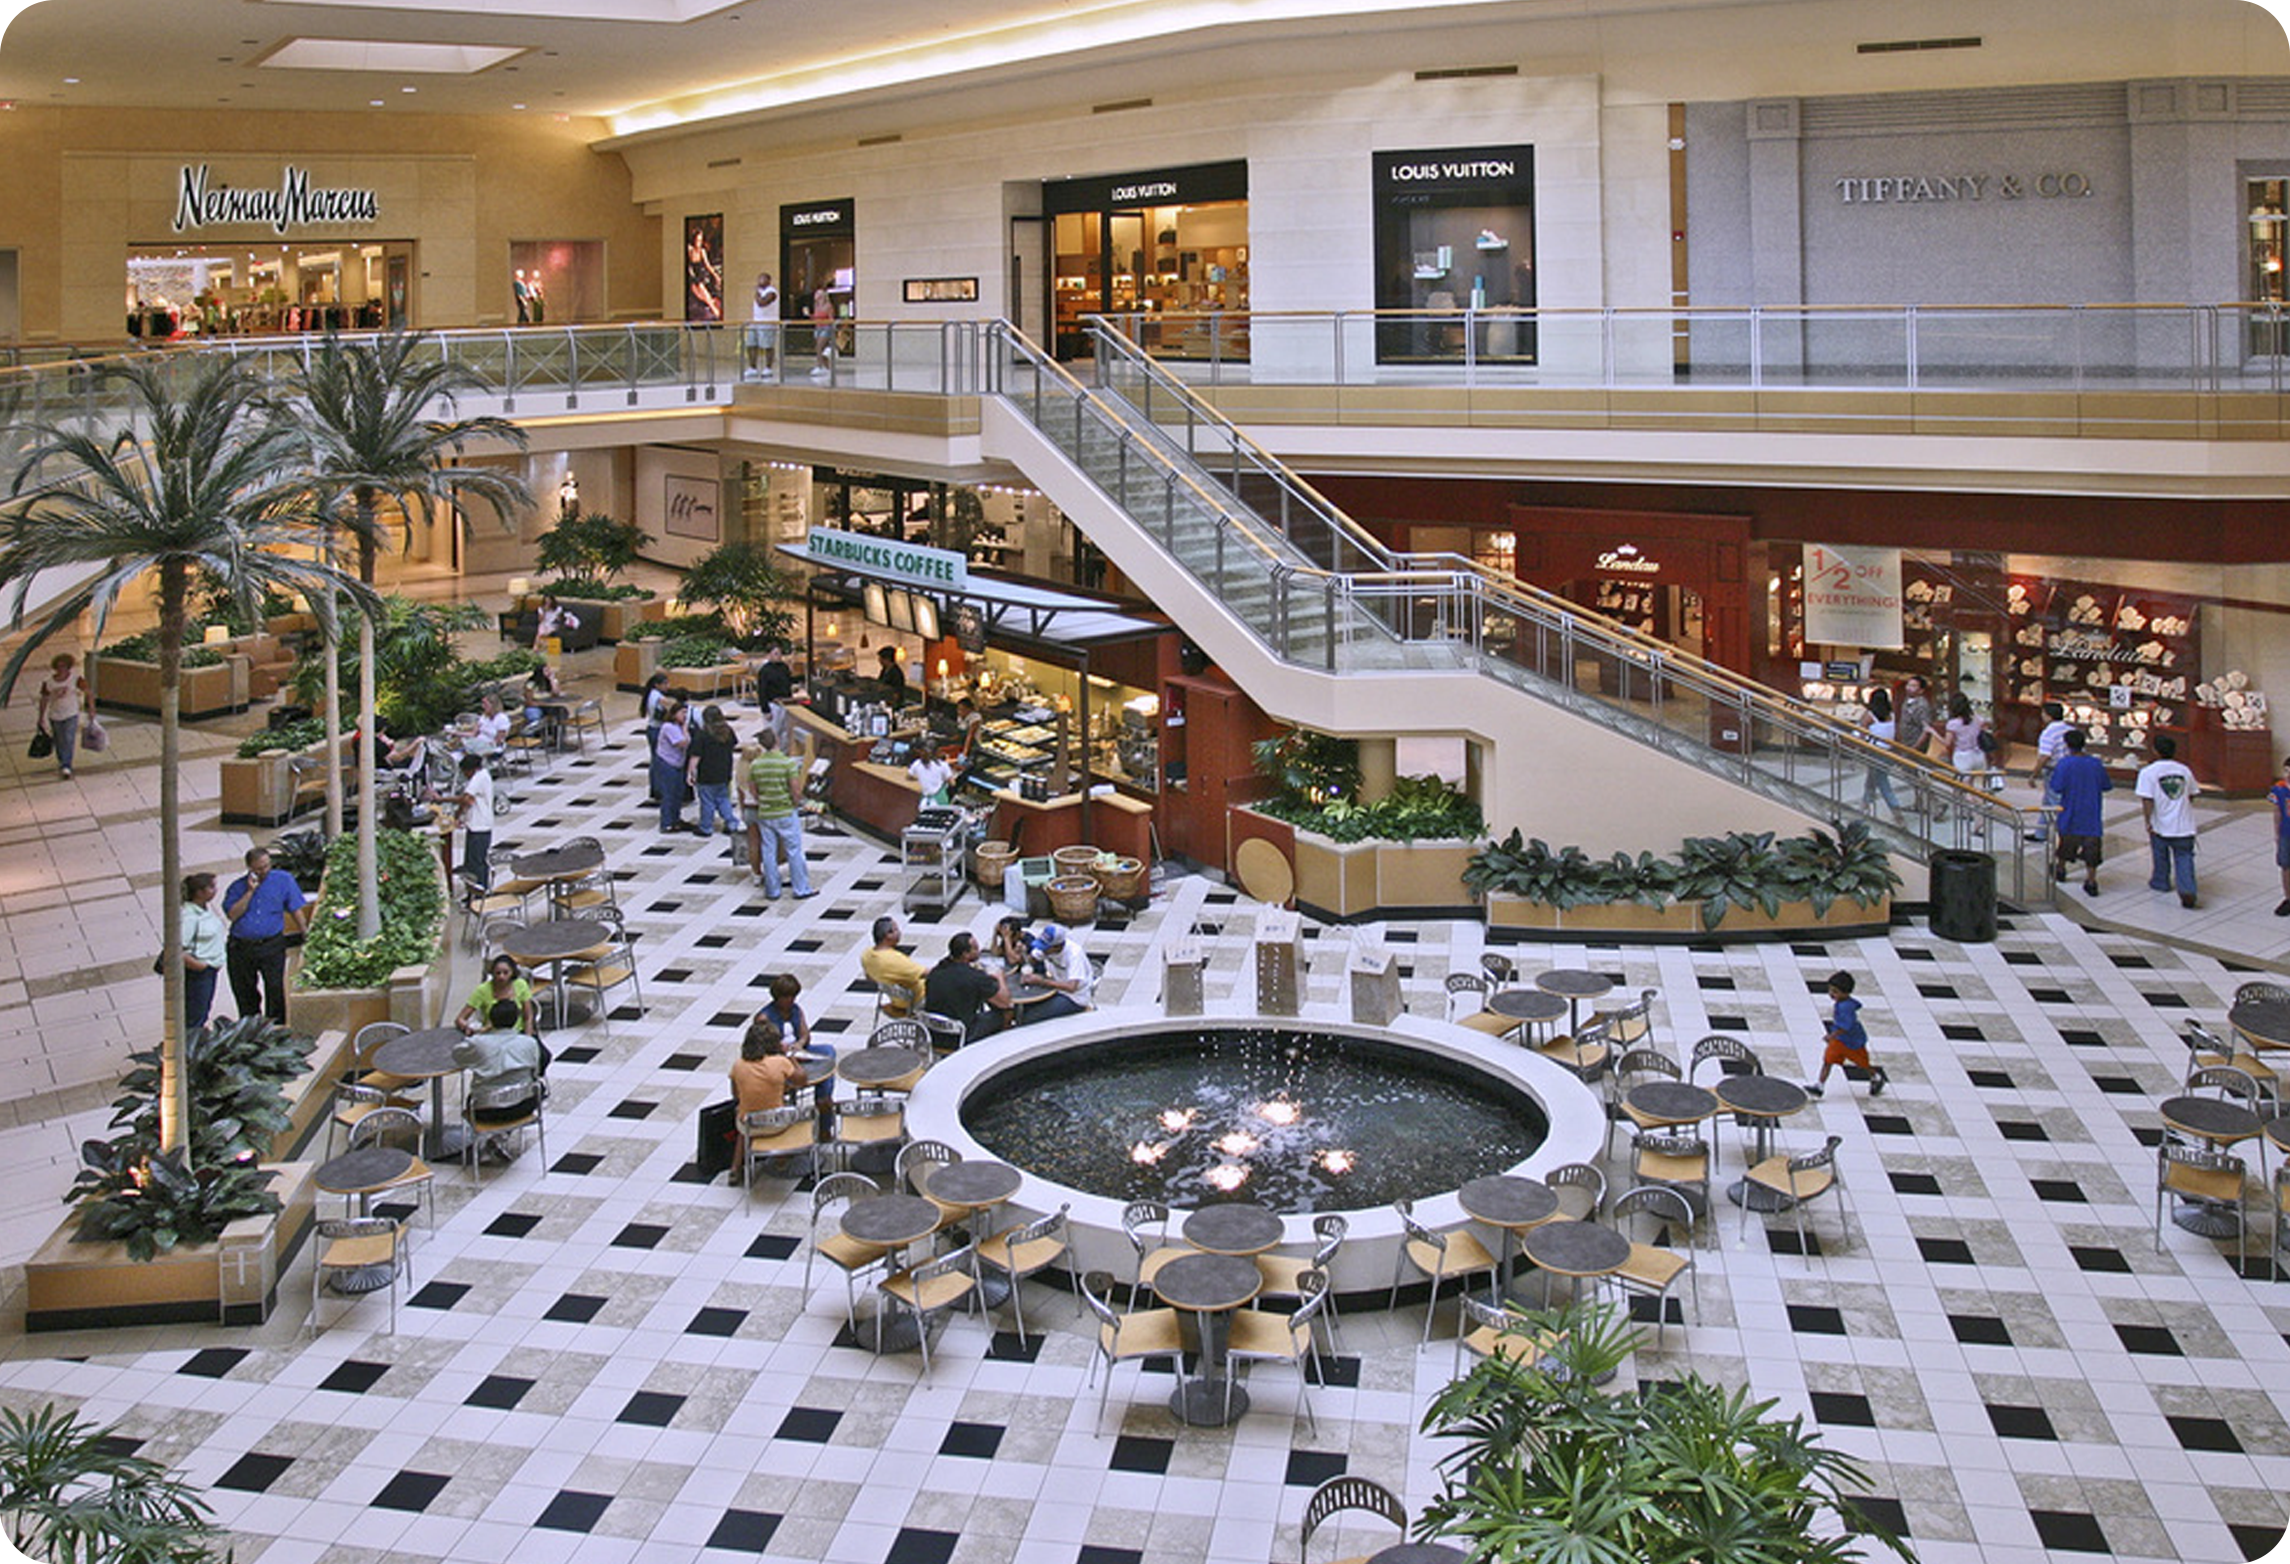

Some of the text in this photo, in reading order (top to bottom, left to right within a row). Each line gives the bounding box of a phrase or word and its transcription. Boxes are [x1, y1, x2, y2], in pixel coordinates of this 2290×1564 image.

[1391, 161, 1515, 180] LOUIS VUITTON
[1112, 183, 1176, 201] LOUIS VUITTON
[1836, 173, 2093, 201] TIFFANY & CO.
[174, 165, 378, 233] Neiman Marcus
[809, 533, 954, 581] STARBUCKS COFFEE
[1854, 564, 1884, 578] OFF
